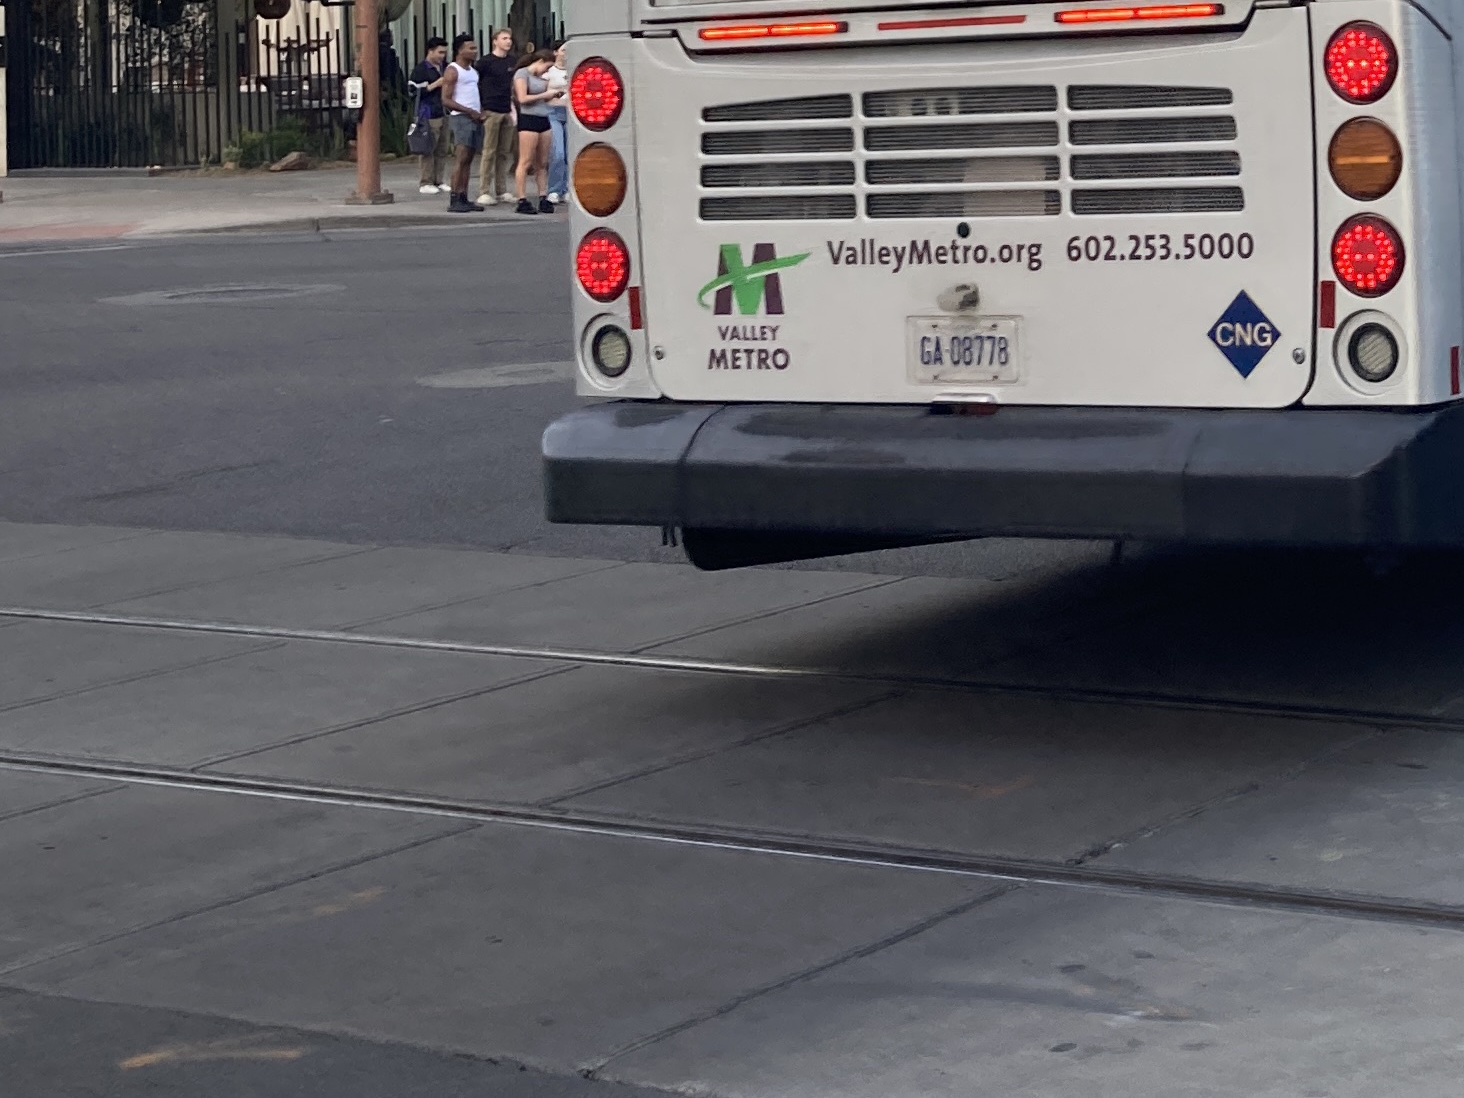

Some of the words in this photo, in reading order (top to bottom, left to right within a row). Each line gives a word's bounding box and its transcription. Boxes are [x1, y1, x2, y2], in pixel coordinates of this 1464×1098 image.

[826, 237, 1043, 272] ValleyMetro.org
[1066, 232, 1255, 264] 602.253.5000
[718, 324, 782, 341] VALLEY
[1216, 320, 1273, 349] CNG
[708, 348, 791, 370] METRO
